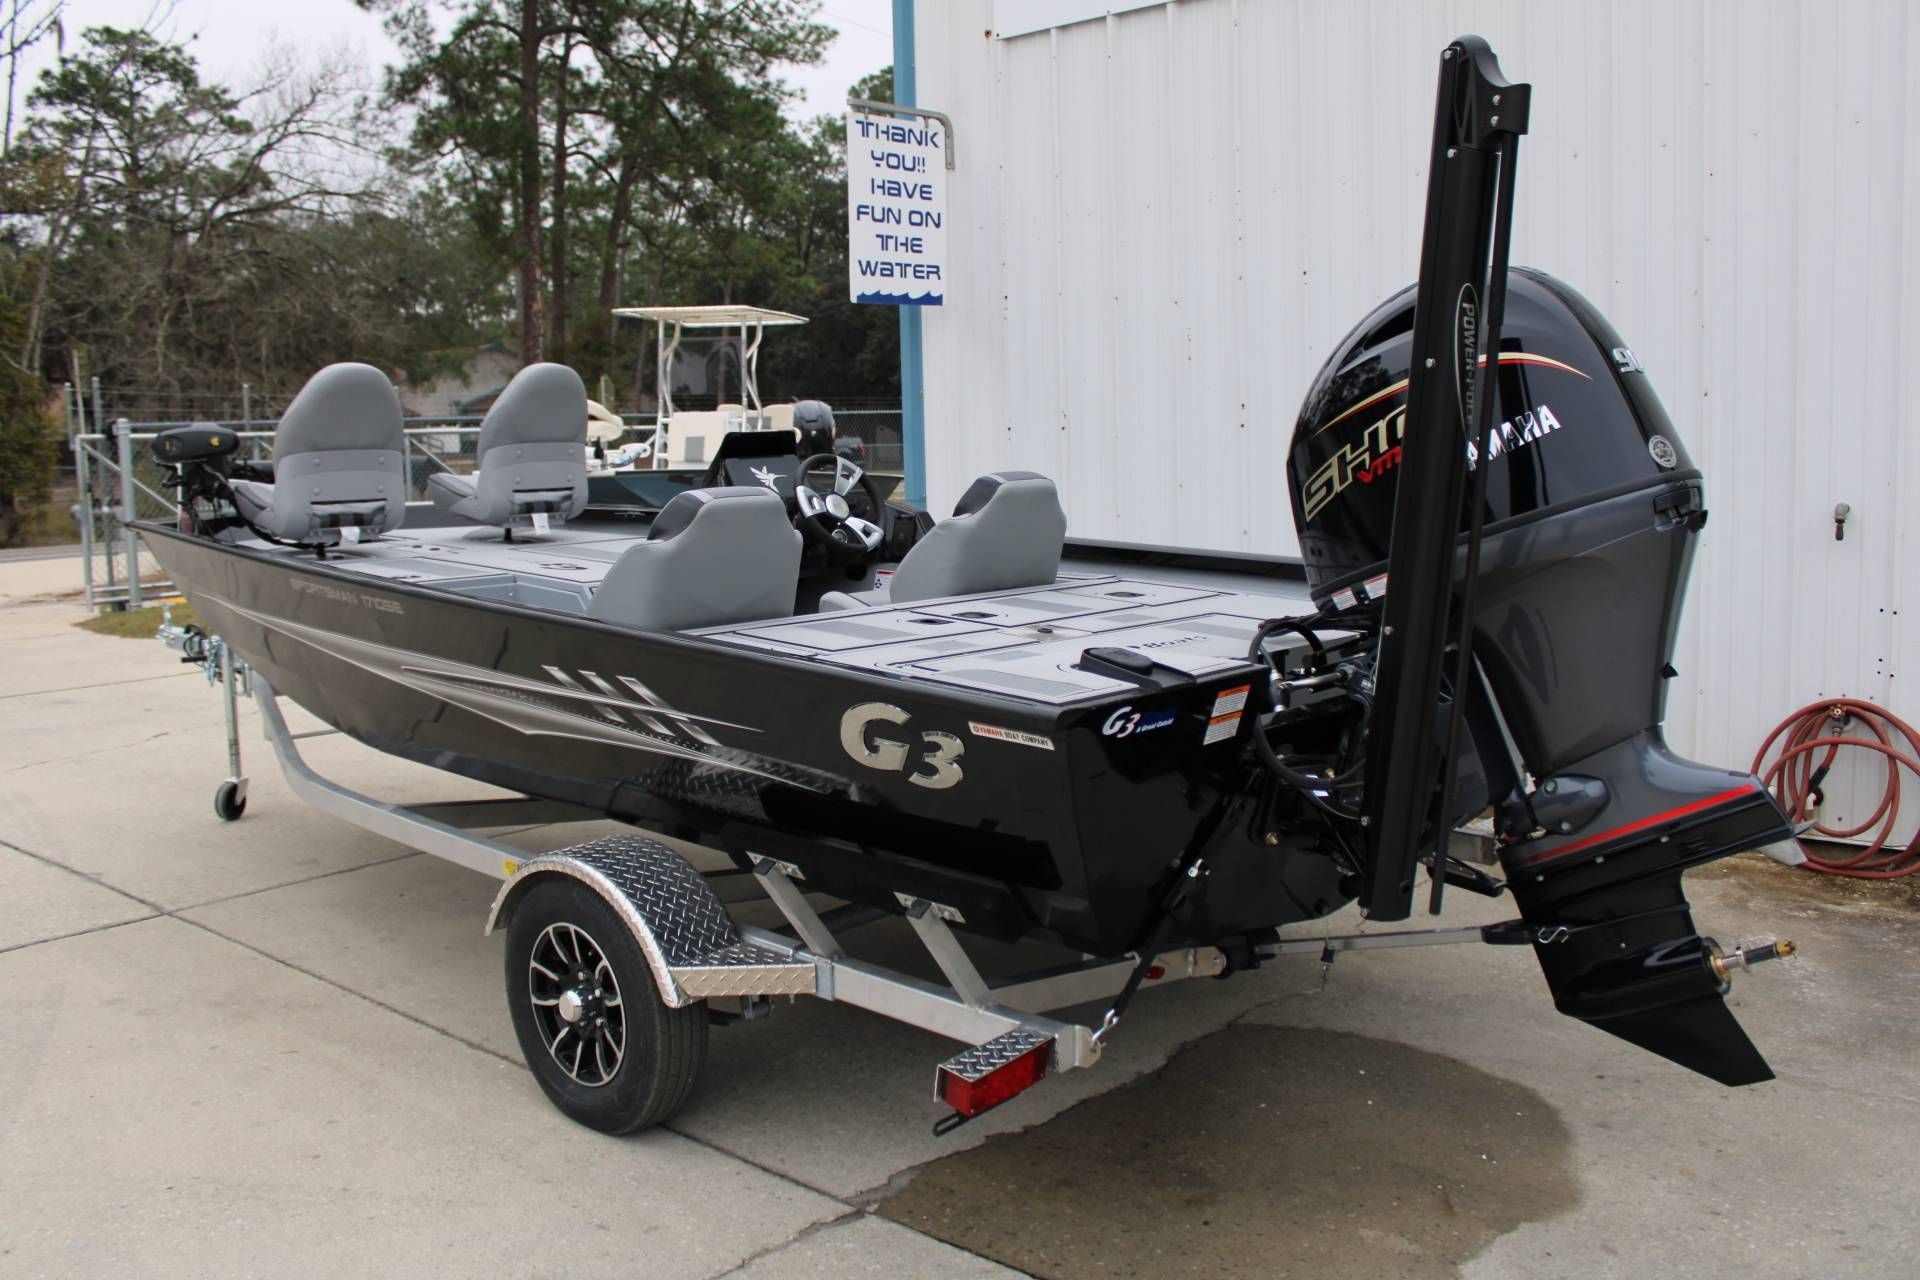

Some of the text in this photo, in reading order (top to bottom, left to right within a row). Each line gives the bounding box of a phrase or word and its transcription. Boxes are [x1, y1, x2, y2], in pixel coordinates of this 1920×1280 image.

[855, 119, 940, 148] THANK
[870, 149, 926, 173] YOU!!
[870, 177, 933, 201] HAVE
[856, 204, 941, 229] FUN ON
[875, 233, 923, 253] THE
[857, 259, 941, 280] WATER
[1101, 705, 1142, 738] G3
[840, 701, 966, 789] G3
[980, 727, 1049, 747] YAMAHA BOAT COMPANY
